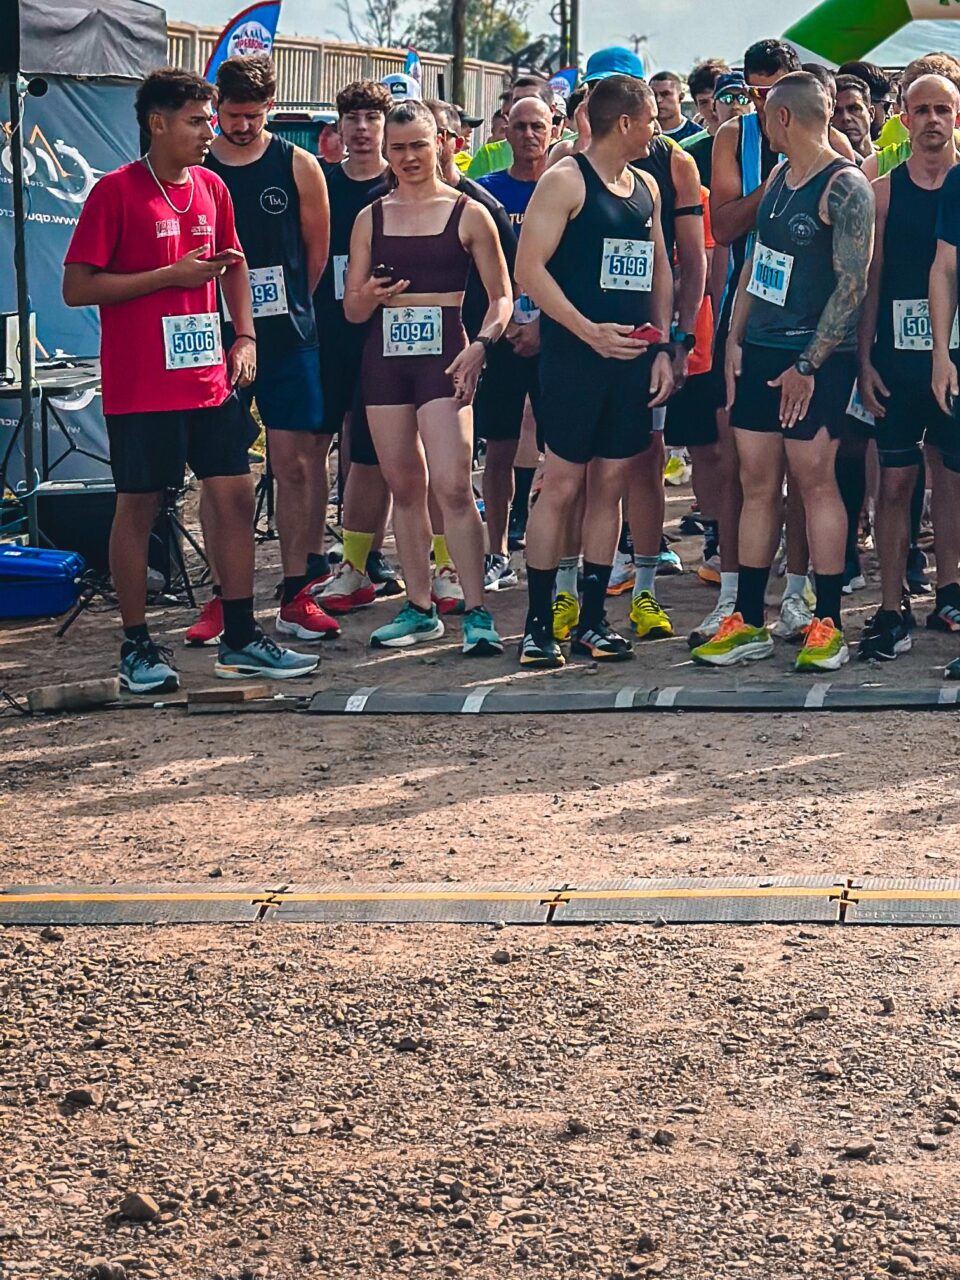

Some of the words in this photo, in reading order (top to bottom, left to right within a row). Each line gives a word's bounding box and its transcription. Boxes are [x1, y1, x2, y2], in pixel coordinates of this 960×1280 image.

[612, 256, 645, 276] 5196
[759, 263, 779, 289] 1011
[253, 283, 277, 303] 93
[391, 323, 433, 341] 5094
[907, 317, 933, 336] 50
[174, 331, 213, 353] 5006
